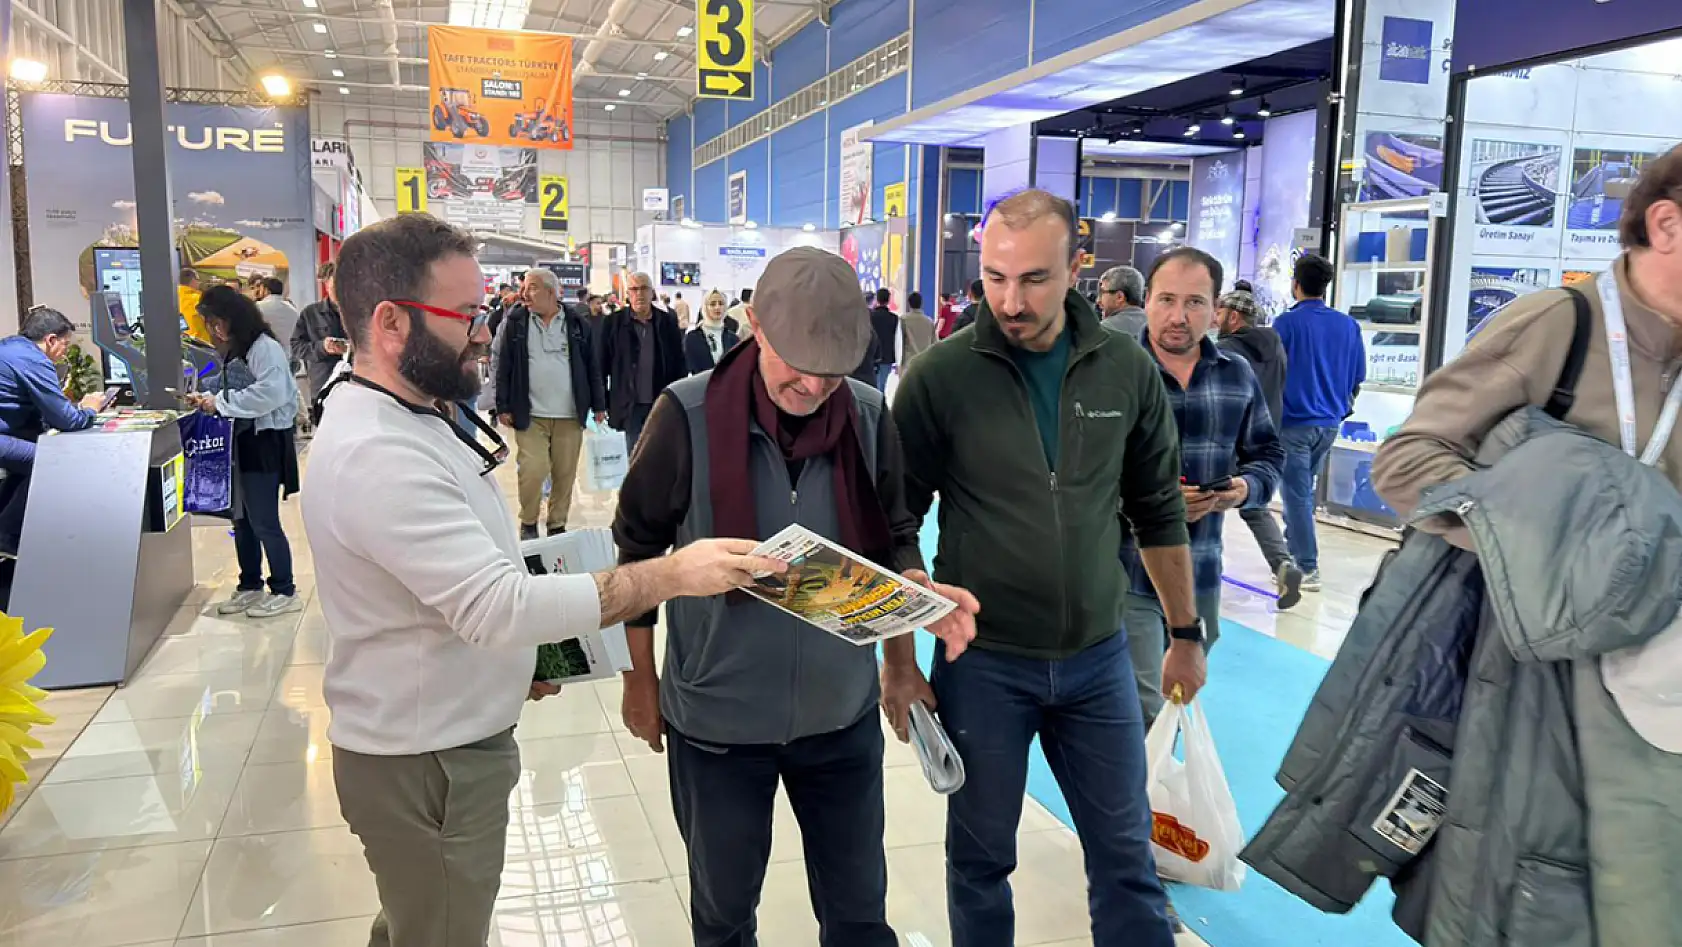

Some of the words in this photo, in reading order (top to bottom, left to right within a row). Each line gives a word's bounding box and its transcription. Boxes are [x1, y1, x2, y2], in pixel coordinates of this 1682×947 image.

[706, 0, 744, 65] 3
[443, 53, 464, 63] TAFE
[467, 56, 516, 68] TRACTORS
[65, 119, 284, 153] FUURE
[403, 176, 419, 211] 1
[544, 182, 565, 217] 2
[1479, 228, 1507, 239] Üretim
[1508, 231, 1535, 242] Sanayi
[1571, 232, 1596, 244] Taşıma
[1598, 235, 1606, 243] ve
